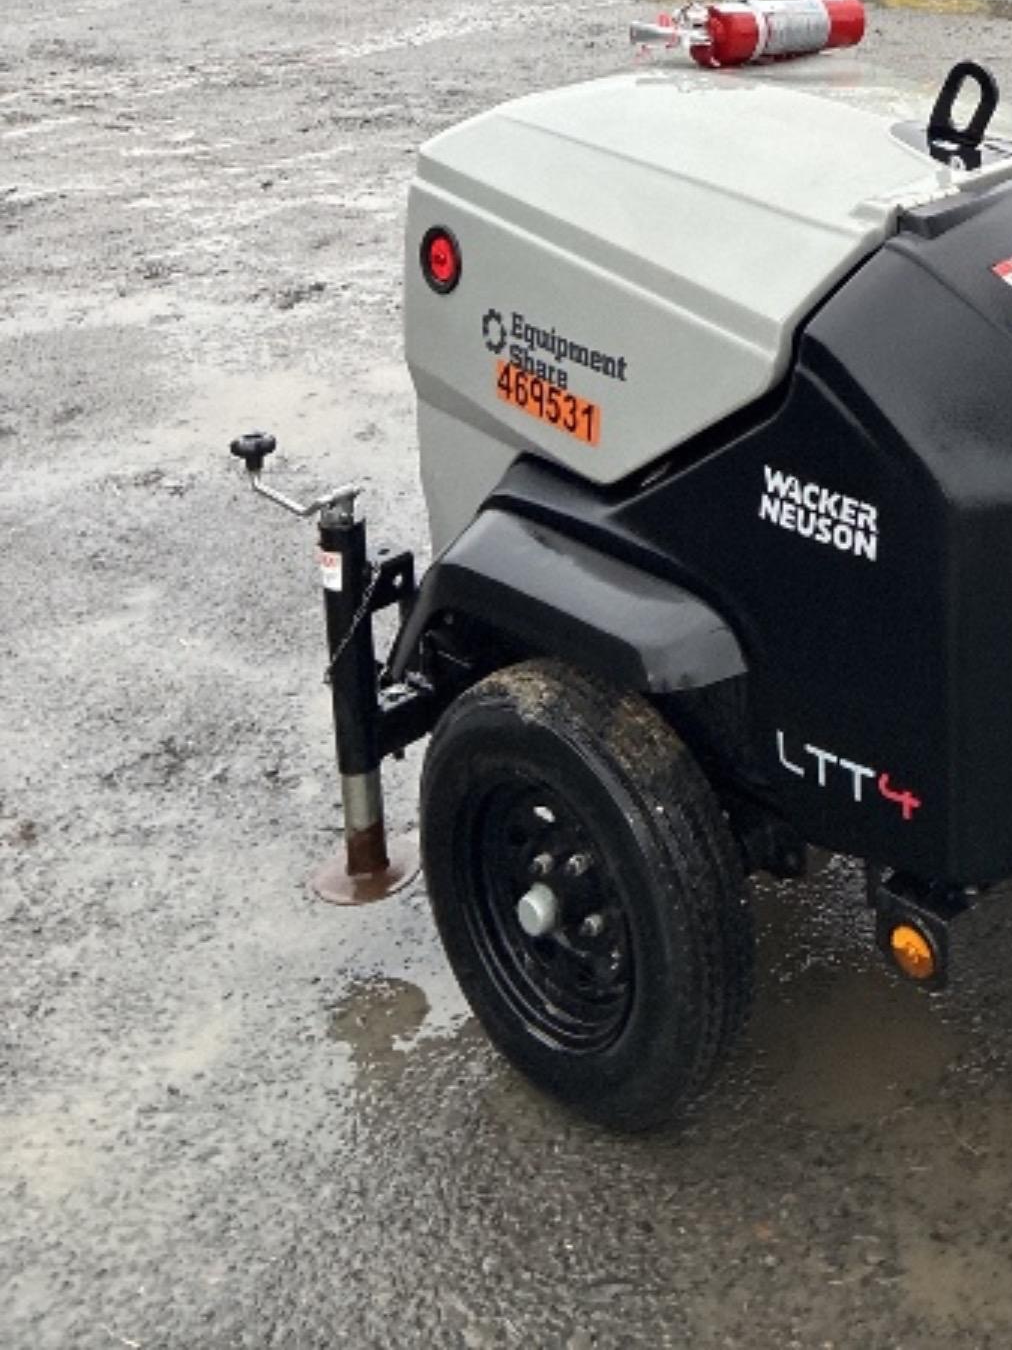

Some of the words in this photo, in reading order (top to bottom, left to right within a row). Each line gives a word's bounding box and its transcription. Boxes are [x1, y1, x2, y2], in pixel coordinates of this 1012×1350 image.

[509, 344, 568, 390] Share
[511, 311, 628, 381] Equipment
[497, 363, 595, 442] 469531
[758, 493, 878, 562] NEUSON
[763, 464, 879, 533] WACKER
[776, 729, 922, 821] LTT4
